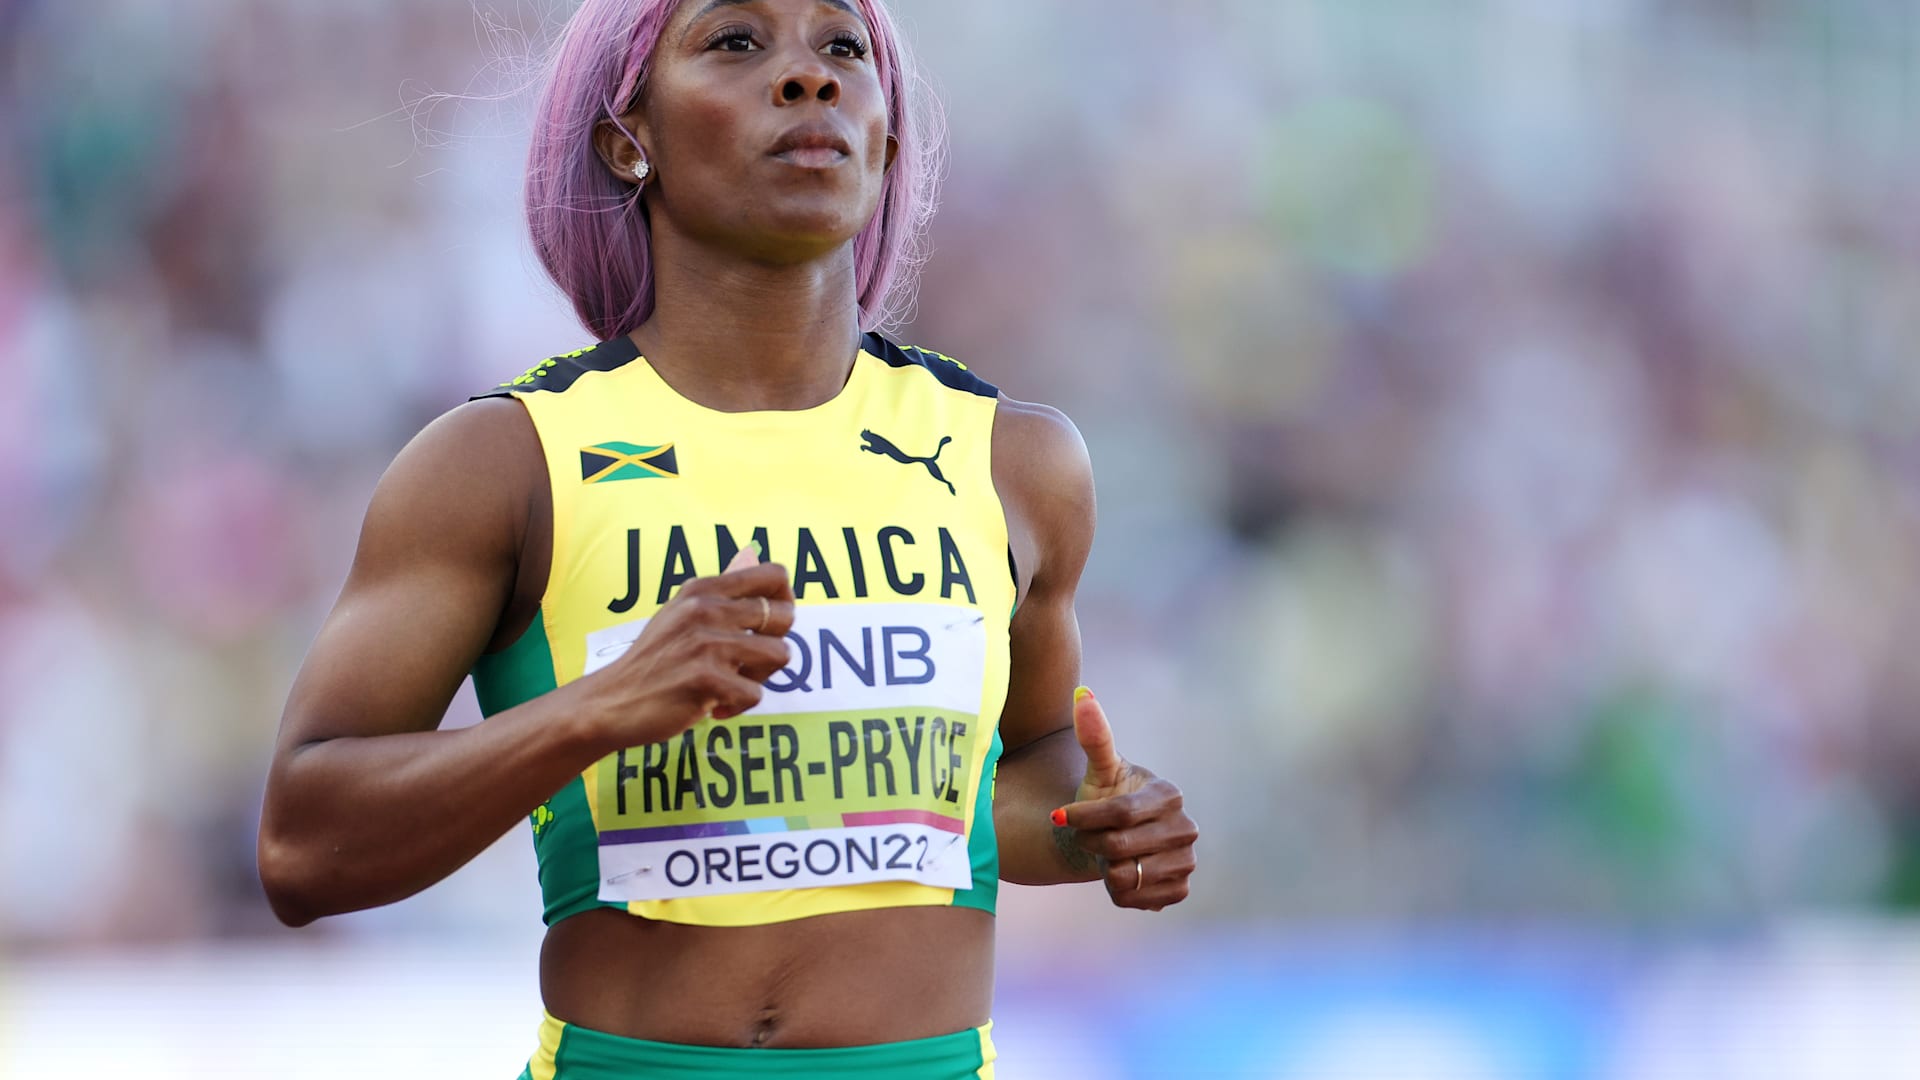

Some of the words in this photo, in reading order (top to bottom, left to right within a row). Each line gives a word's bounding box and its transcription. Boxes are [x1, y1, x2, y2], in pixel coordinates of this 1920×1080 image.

[607, 524, 977, 613] JAMAICA
[616, 716, 967, 815] FRASER-PRYCE
[665, 834, 929, 887] OREGON22
